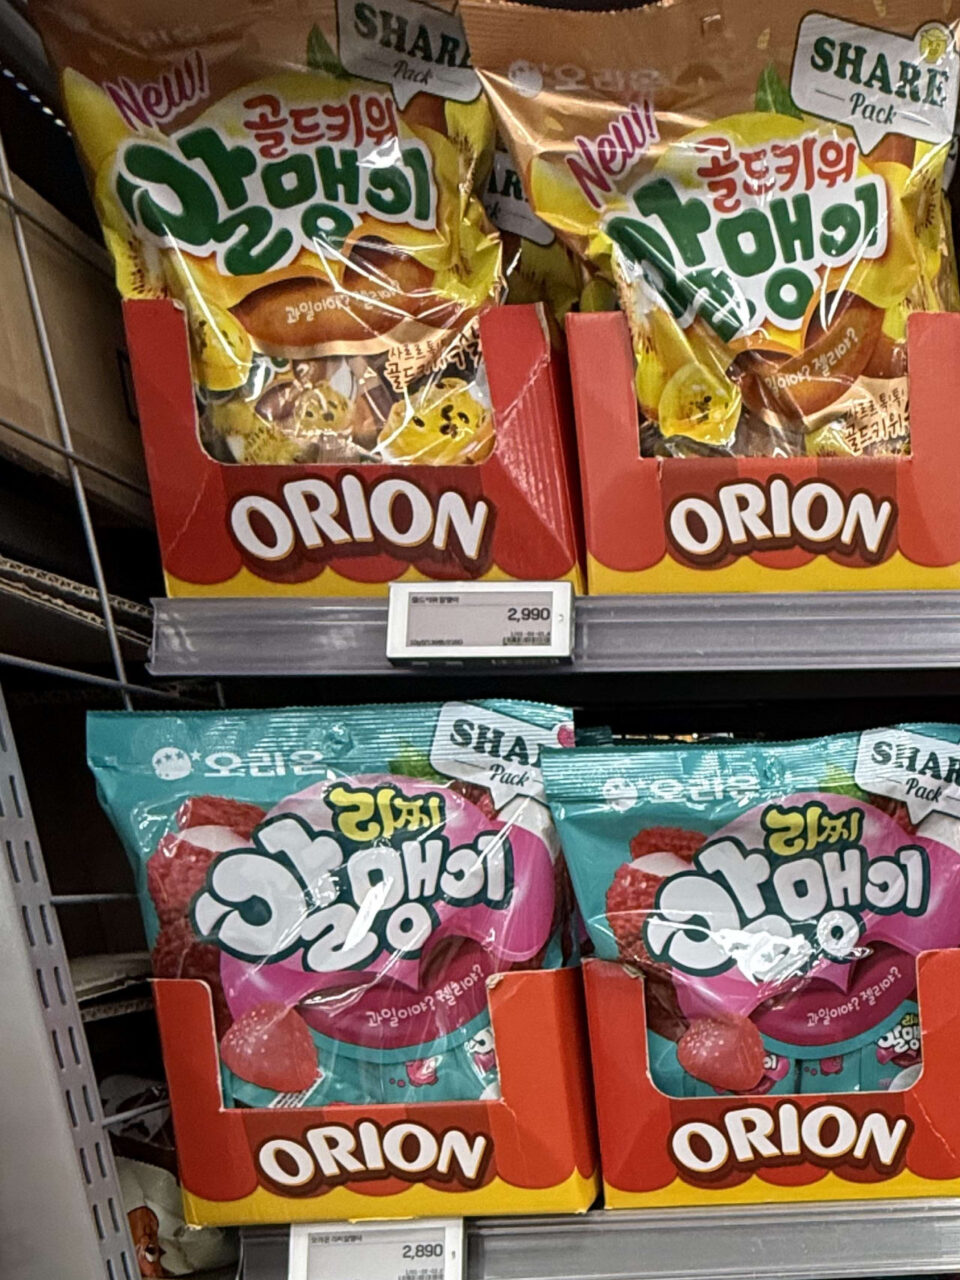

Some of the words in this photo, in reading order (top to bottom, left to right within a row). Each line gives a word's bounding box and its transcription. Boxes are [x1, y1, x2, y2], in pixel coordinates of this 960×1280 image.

[108, 53, 209, 131] New!
[393, 60, 432, 86] Pack
[810, 35, 949, 108] SHARE
[244, 94, 399, 158] 골드키위
[849, 92, 898, 126] Pack
[565, 99, 658, 208] New!
[696, 136, 857, 213] 골드키위
[117, 127, 434, 276] 알맹이
[606, 178, 879, 344] 알맹이
[813, 326, 859, 378] 젤리야?
[231, 473, 488, 561] ORION
[669, 478, 892, 555] ORION
[507, 607, 551, 623] 2,990
[203, 748, 329, 778] 오리온
[449, 717, 544, 766] SHA
[488, 762, 531, 788] Pack
[904, 776, 943, 803] Pack
[195, 818, 512, 973] 알맹이
[646, 840, 923, 984] 알맹이
[366, 991, 438, 1028] 과일이야?
[806, 997, 862, 1028] 과일이야?
[860, 965, 903, 1007] 젤리야?
[257, 1119, 487, 1188] ORION
[673, 1104, 907, 1173] ORION
[402, 1243, 444, 1260] 2,890
